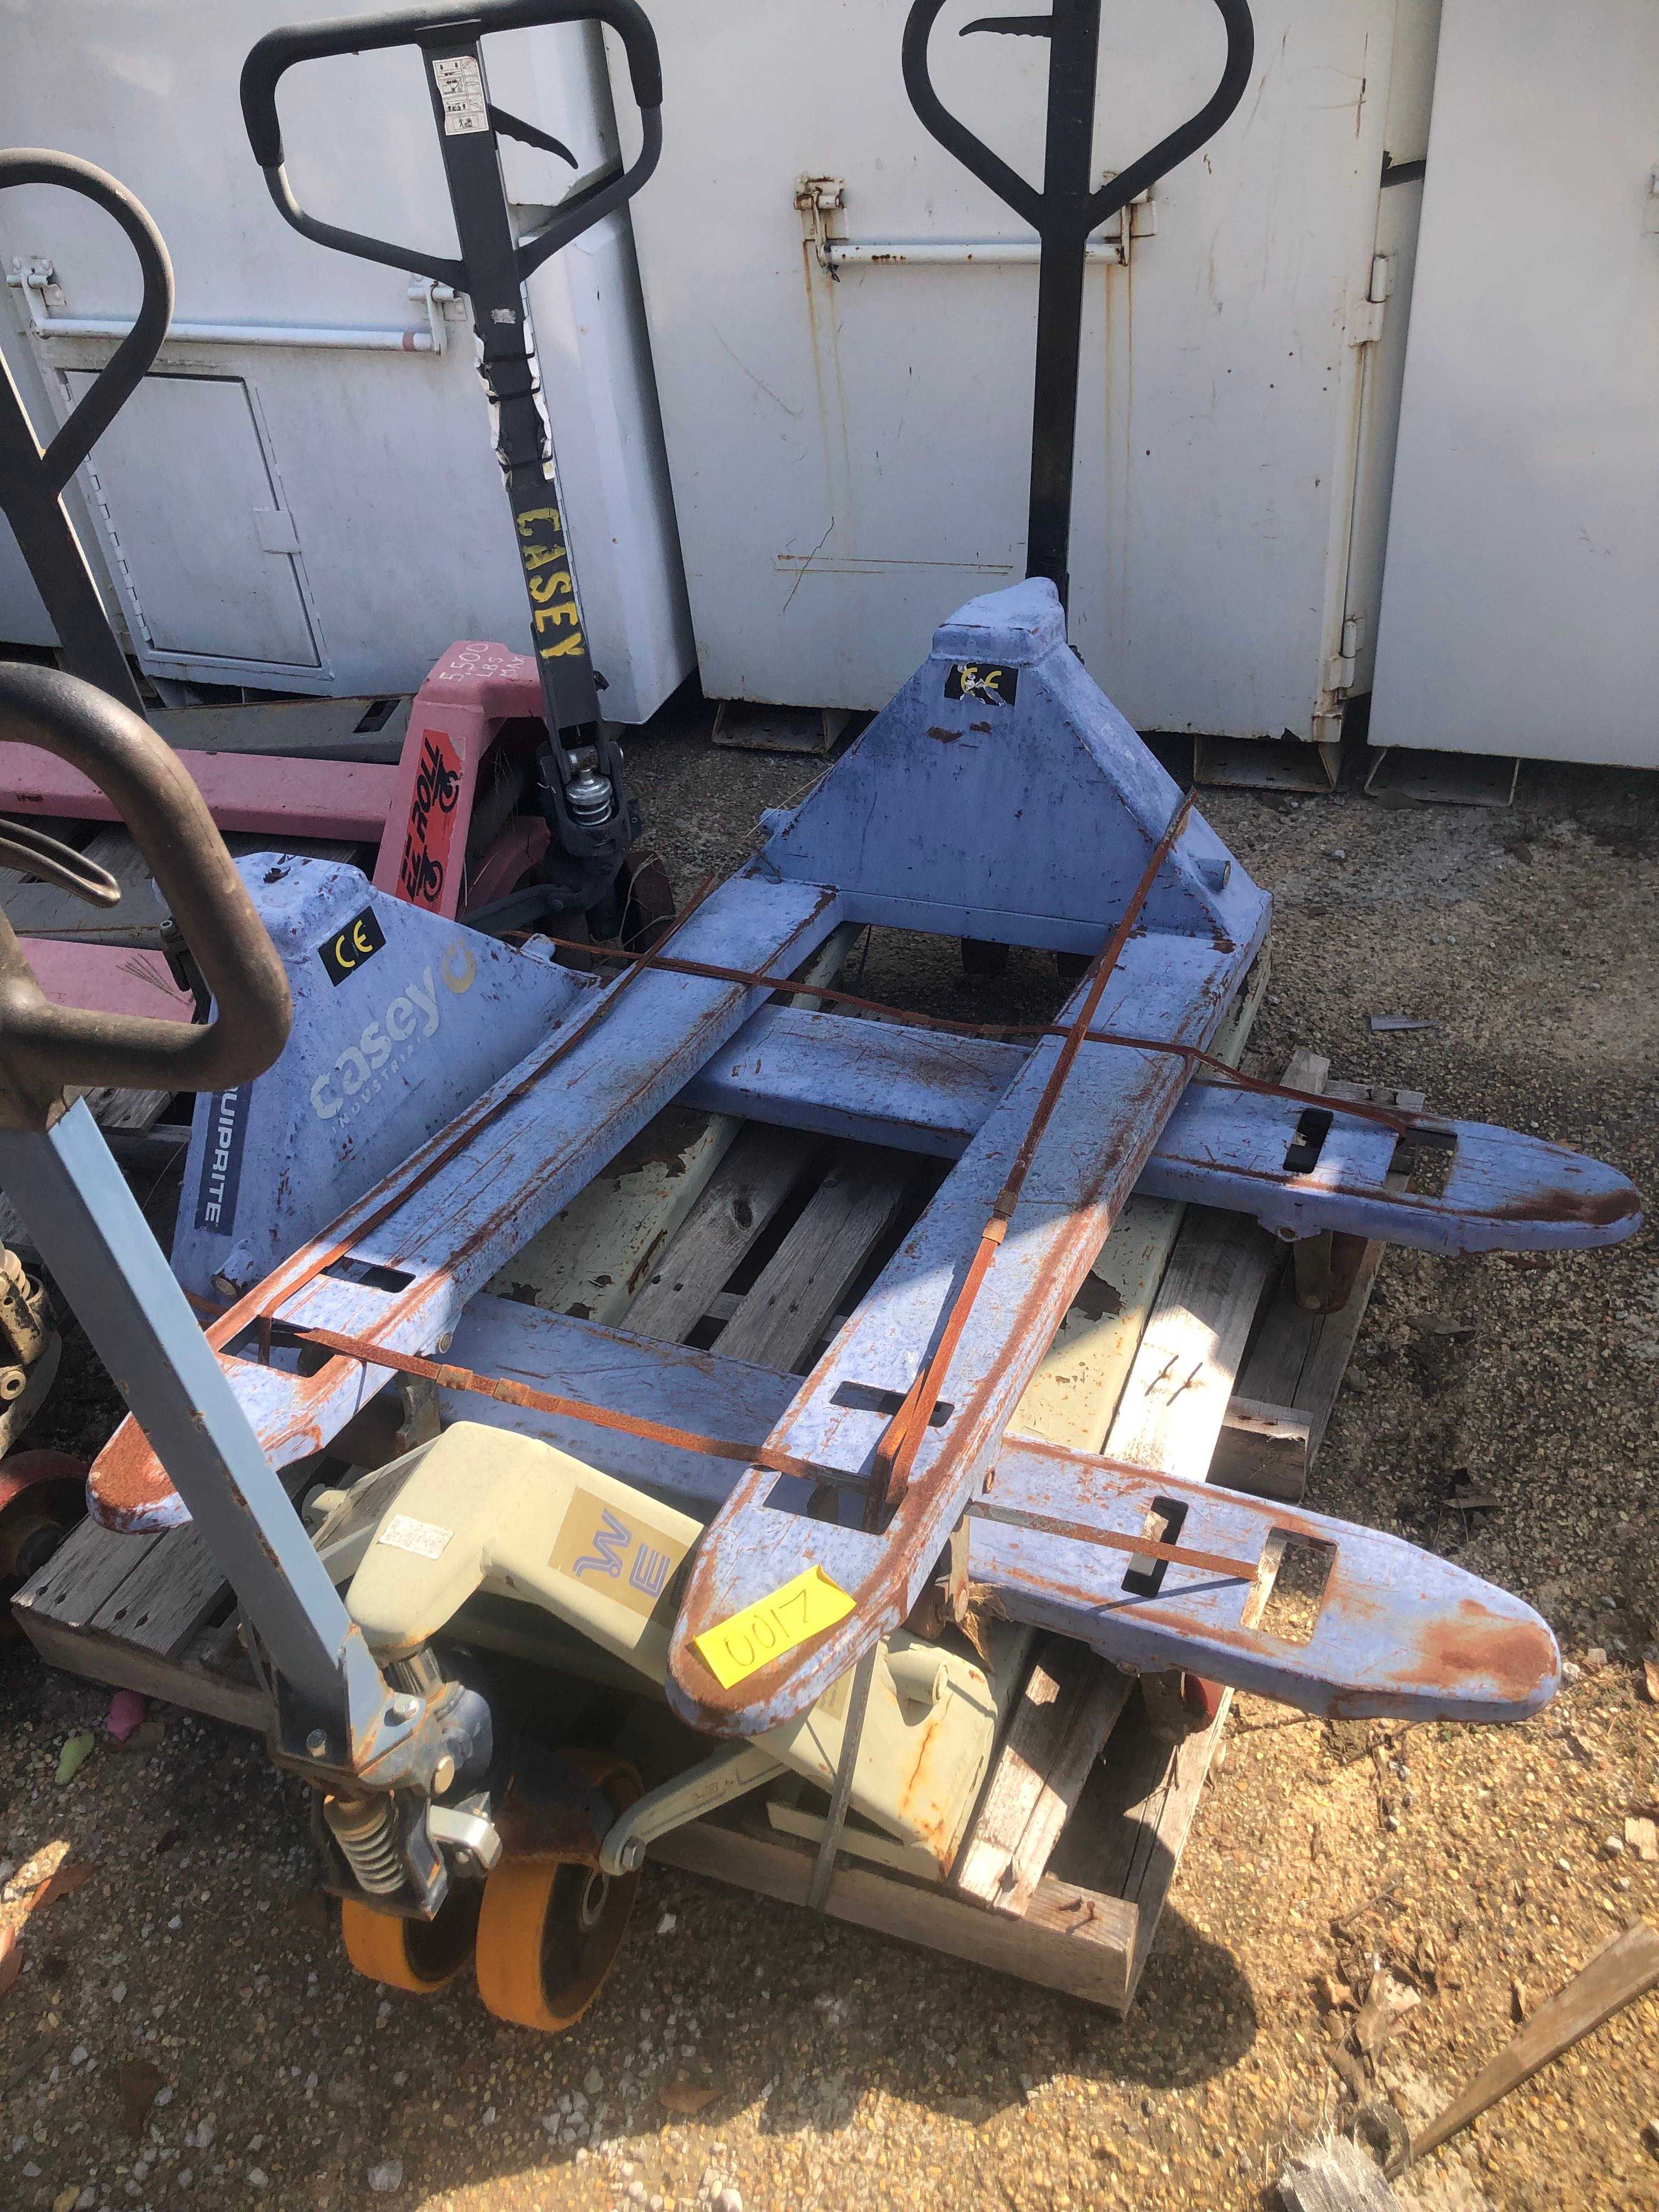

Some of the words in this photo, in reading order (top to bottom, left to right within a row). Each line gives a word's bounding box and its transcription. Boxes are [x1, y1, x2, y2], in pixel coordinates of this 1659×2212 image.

[516, 507, 585, 658] CASEY
[439, 643, 489, 681] 5,500
[477, 657, 503, 678] LBS
[499, 656, 527, 678] MAX
[412, 737, 439, 844] ROLL
[335, 919, 373, 968] CE
[311, 966, 439, 1120] casey
[205, 1086, 239, 1224] UIPRITE
[724, 1589, 809, 1666] 0017
